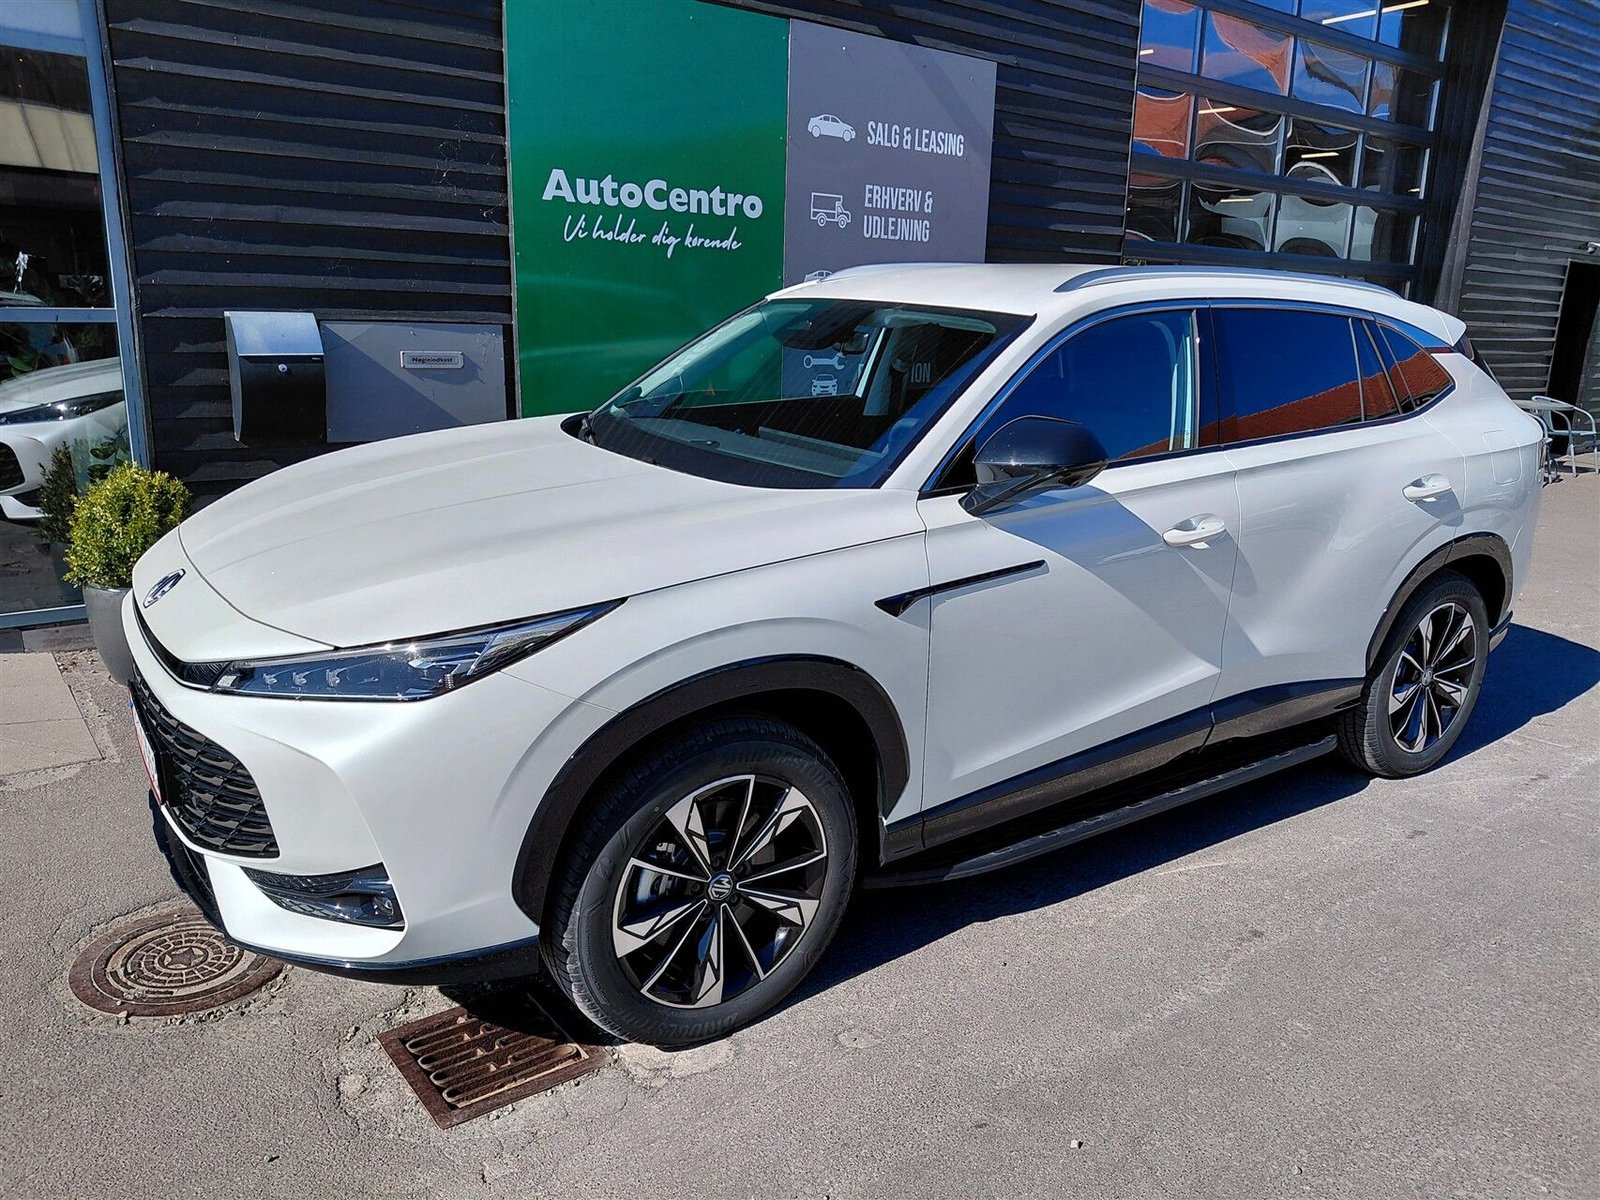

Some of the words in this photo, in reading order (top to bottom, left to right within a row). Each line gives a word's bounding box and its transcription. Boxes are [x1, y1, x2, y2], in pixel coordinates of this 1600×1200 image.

[867, 121, 900, 148] SALG
[903, 127, 912, 150] &
[914, 128, 964, 157] LEASING
[542, 169, 763, 219] AutoCentro
[864, 184, 922, 212] ERHVERV
[924, 191, 933, 213] &
[564, 214, 589, 242] Vi
[592, 213, 646, 243] holder
[652, 221, 680, 258] dig
[863, 214, 930, 242] UDLEJNING
[910, 362, 931, 384] ION
